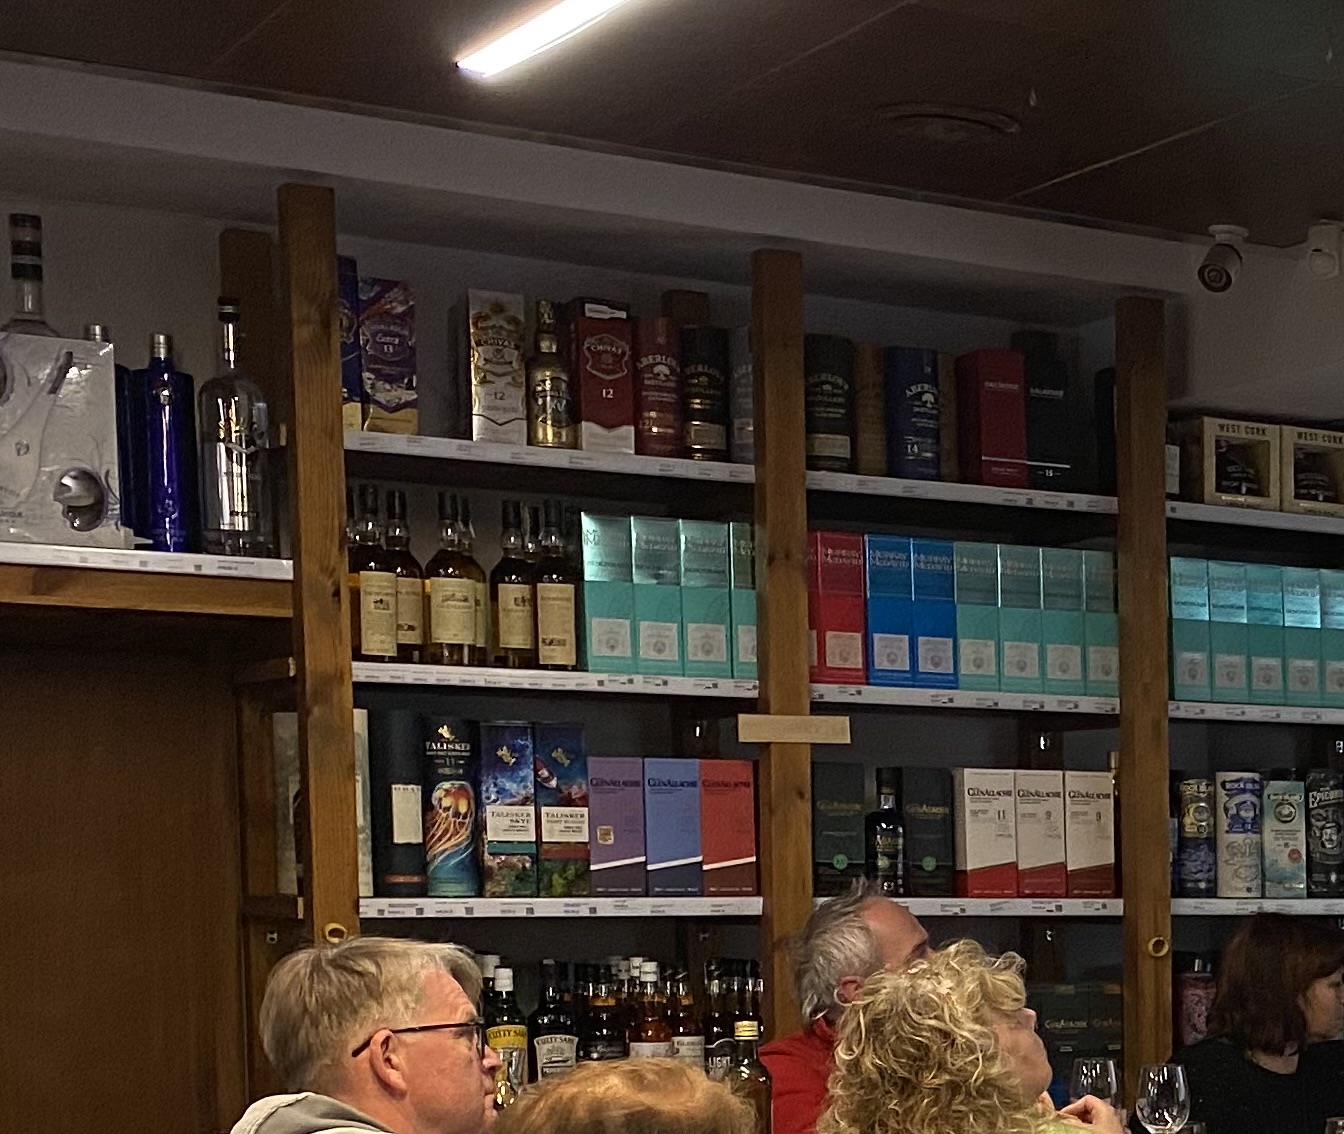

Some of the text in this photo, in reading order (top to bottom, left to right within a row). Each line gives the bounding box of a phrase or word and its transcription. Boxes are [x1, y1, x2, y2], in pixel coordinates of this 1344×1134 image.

[602, 388, 614, 399] 12
[1218, 423, 1267, 437] WEST CORK
[1296, 431, 1344, 445] WEST CORK
[708, 1056, 732, 1069] LIGHT
